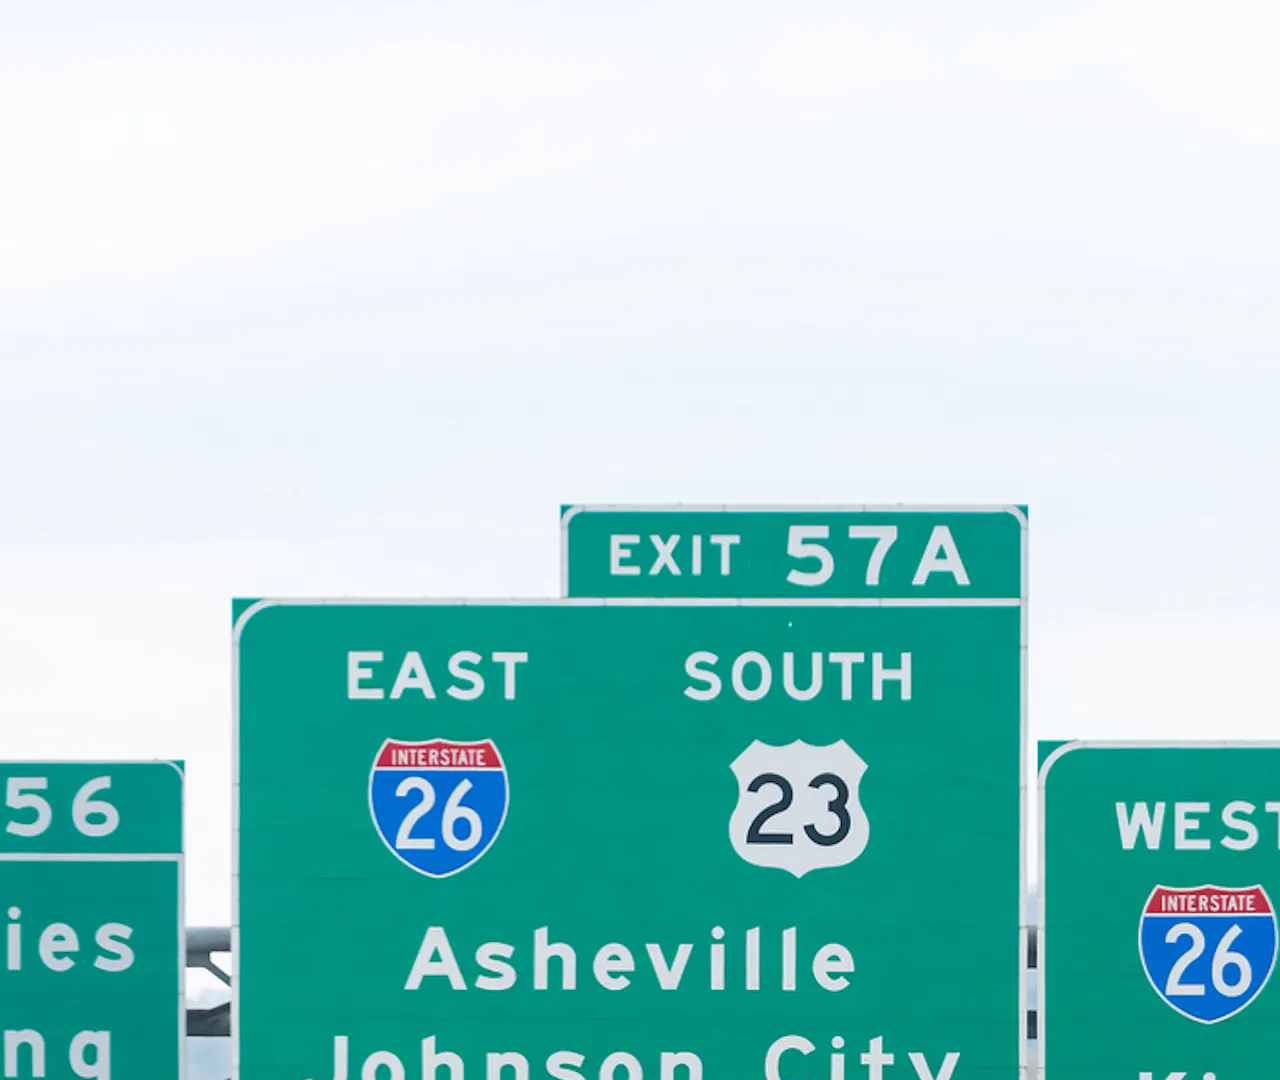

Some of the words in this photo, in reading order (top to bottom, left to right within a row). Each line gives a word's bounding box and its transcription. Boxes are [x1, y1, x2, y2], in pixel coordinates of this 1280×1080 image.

[610, 534, 741, 576] EXIT
[786, 525, 971, 587] 57A
[347, 650, 529, 701] EAST
[683, 650, 912, 701] SOUTH
[391, 748, 486, 767] INTERSTATE
[5, 775, 119, 837] 56
[394, 777, 484, 852] 26
[745, 772, 851, 847] 23
[1160, 894, 1256, 914] INTERSTATE
[404, 925, 855, 992] Asheville
[1164, 922, 1254, 997] 26
